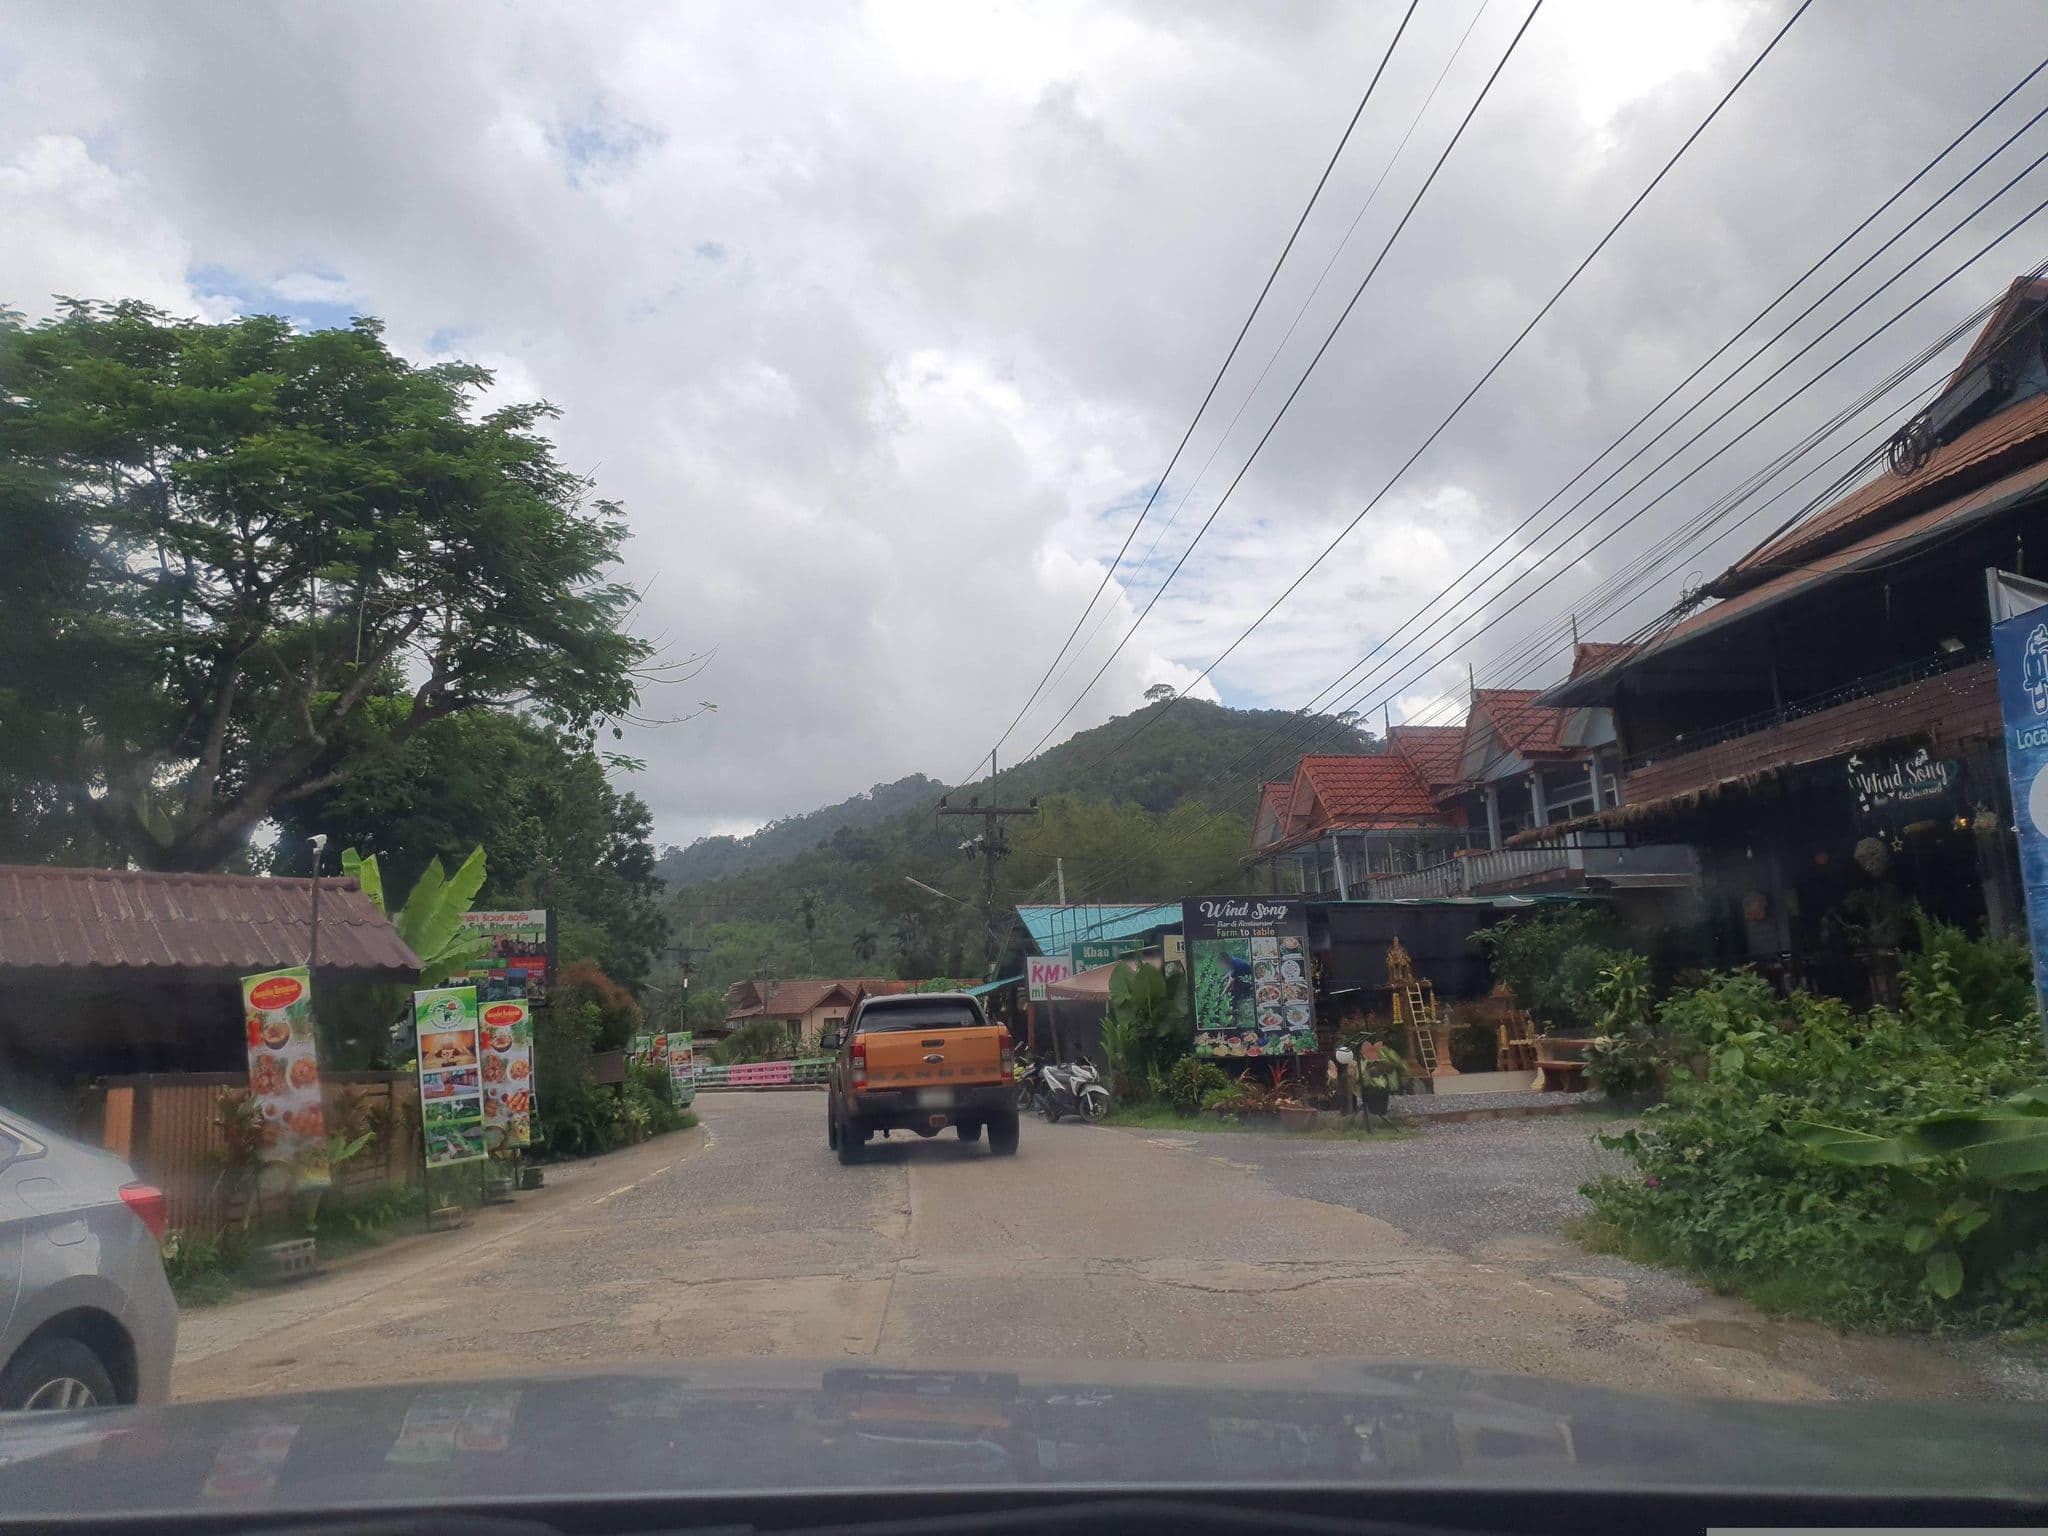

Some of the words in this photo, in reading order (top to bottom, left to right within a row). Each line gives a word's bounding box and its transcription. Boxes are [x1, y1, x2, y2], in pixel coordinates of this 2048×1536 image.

[2016, 722, 2048, 750] Loca
[1858, 763, 1902, 794] Wind
[1906, 761, 1948, 786] Song
[1200, 900, 1249, 918] Wind
[1251, 903, 1288, 919] Song
[1216, 929, 1238, 937] Farm
[1253, 927, 1276, 936] table
[1083, 946, 1109, 958] Khao
